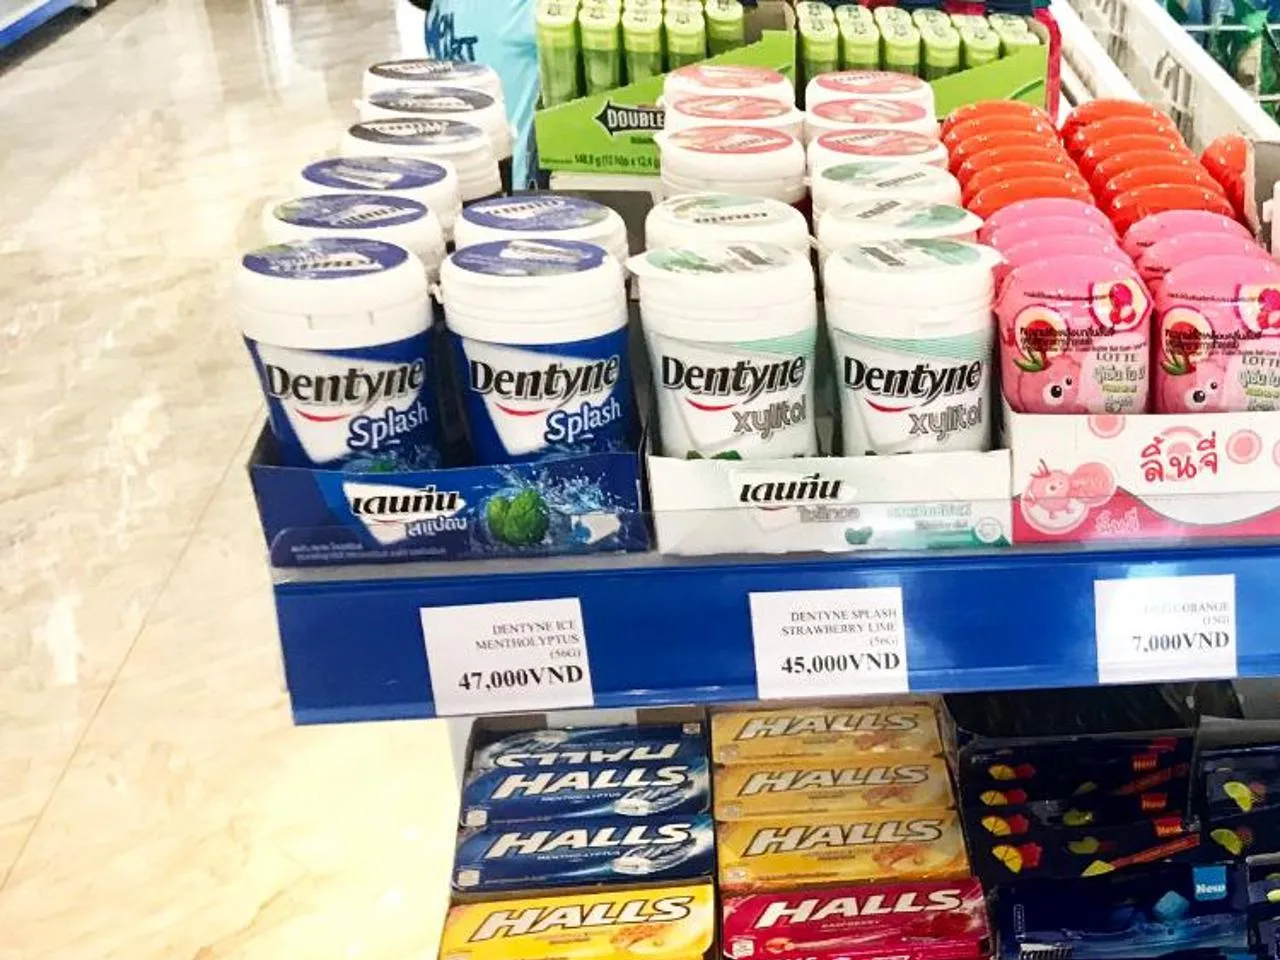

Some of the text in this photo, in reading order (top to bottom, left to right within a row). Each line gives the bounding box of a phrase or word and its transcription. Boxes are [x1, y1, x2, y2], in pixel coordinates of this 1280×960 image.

[606, 108, 665, 128] DOUBLE
[266, 358, 425, 411] Dentyne
[470, 355, 620, 409] Dentyne
[661, 355, 806, 403] Dentyne
[844, 355, 982, 406] Dentyne
[350, 405, 428, 448] Splash
[547, 399, 622, 444] Splash
[732, 394, 807, 438] xylitol
[909, 398, 983, 440] xylitol
[791, 608, 898, 623] DENTYNE SPLASH
[1180, 600, 1230, 613] ORANGE
[476, 634, 580, 651] MENTHOLYPTUS
[493, 619, 575, 636] DENTYNE ICE
[782, 621, 896, 637] STRAWBERRY LIME
[1132, 630, 1230, 652] 7,000VND
[459, 665, 583, 692] 47,000VND
[781, 651, 901, 675] 45,000VND
[739, 711, 919, 741] HALLS
[492, 765, 689, 799] HALLS
[740, 764, 930, 797] HALLS
[485, 823, 692, 859] HALLS
[746, 818, 945, 859] HALLS
[1196, 883, 1226, 894] New
[469, 894, 693, 944] HALLS
[755, 889, 962, 929] HALLS
